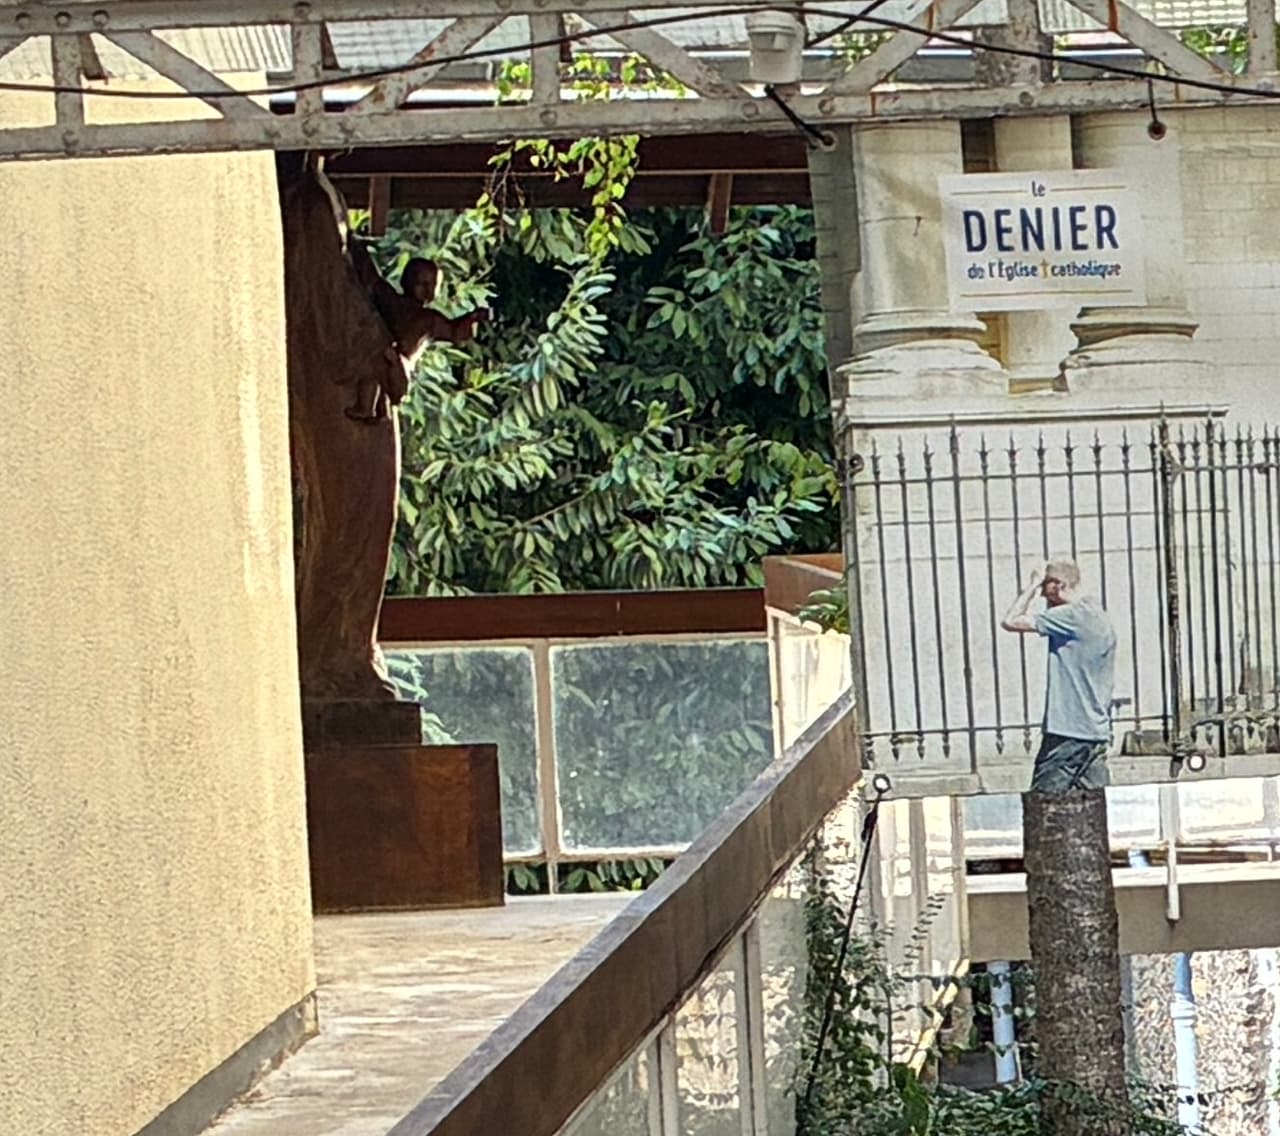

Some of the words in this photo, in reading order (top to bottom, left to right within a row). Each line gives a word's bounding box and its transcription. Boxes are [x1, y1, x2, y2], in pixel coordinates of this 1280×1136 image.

[962, 204, 1120, 253] DENIER
[967, 261, 985, 280] de
[1050, 260, 1121, 280] catholique
